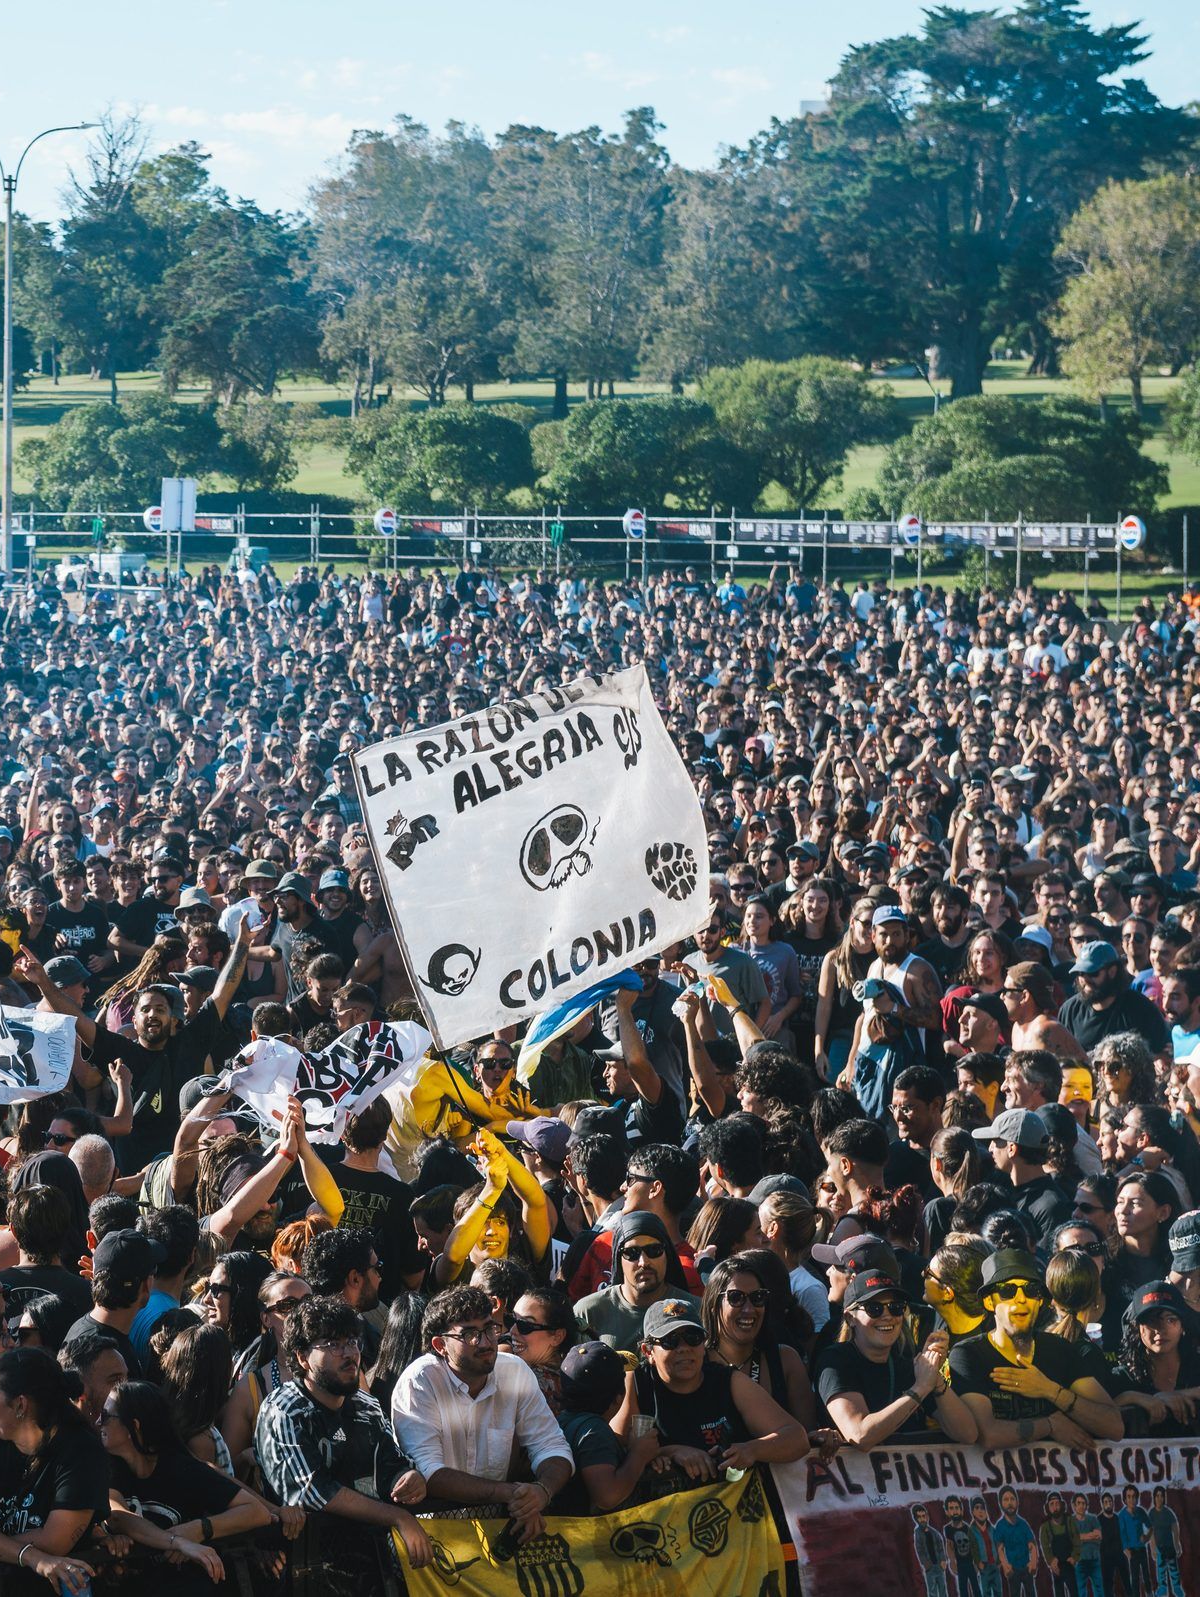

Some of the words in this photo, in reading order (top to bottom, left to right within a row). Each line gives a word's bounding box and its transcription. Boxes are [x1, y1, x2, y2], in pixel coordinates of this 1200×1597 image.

[360, 752, 412, 797] LA
[415, 697, 540, 775] RAZON
[453, 711, 604, 814] ALEGRIA
[499, 907, 656, 1009] COLONIA
[368, 1193, 392, 1213] IN
[805, 1455, 864, 1501] AL
[983, 1447, 1070, 1487] SABES
[1071, 1447, 1116, 1488] SOS
